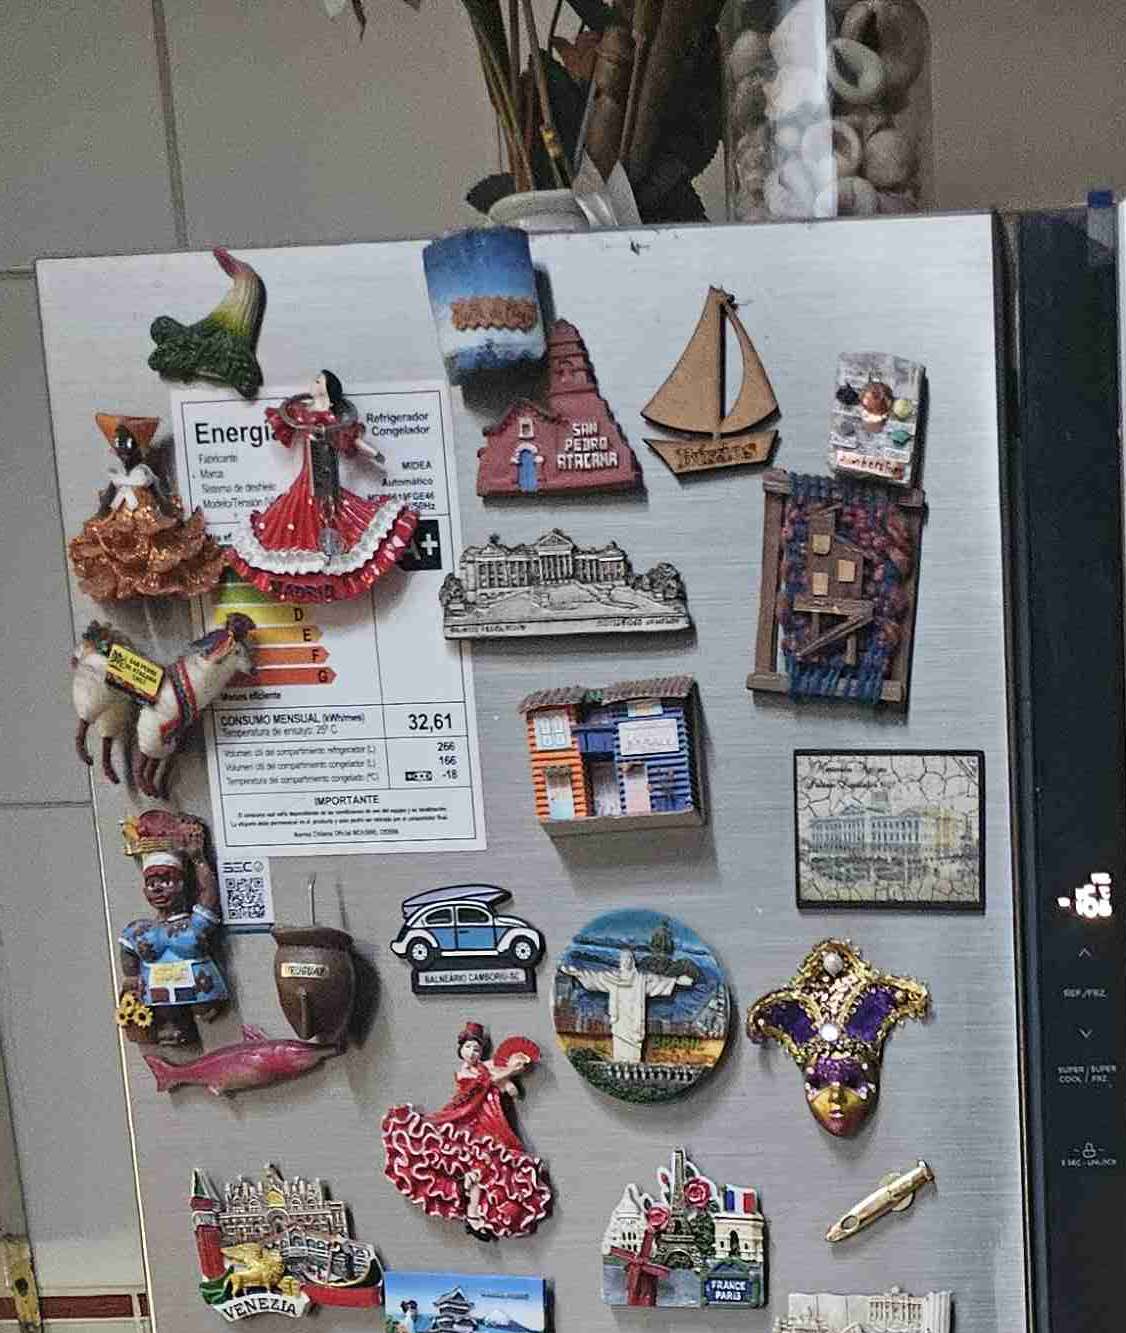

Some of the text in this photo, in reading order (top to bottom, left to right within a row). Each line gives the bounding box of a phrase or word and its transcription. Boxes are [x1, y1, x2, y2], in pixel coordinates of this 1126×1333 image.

[366, 412, 428, 425] Refrigerador
[372, 424, 430, 436] Congelador
[572, 423, 598, 436] SAN
[565, 436, 608, 451] PEDRO
[402, 460, 432, 470] MIDEA
[557, 451, 618, 470] ATACAMA
[294, 607, 304, 621] D
[303, 628, 311, 642] E
[312, 649, 320, 661] F
[318, 669, 327, 683] G
[221, 714, 271, 726] CONSUMO
[273, 712, 320, 724] MENSUAL
[408, 713, 452, 732] 32,61
[314, 794, 379, 806] IMPORTANTE
[711, 1279, 746, 1291] FRANCE
[715, 1290, 742, 1301] PARIS
[223, 1297, 297, 1319] VENEZIA
